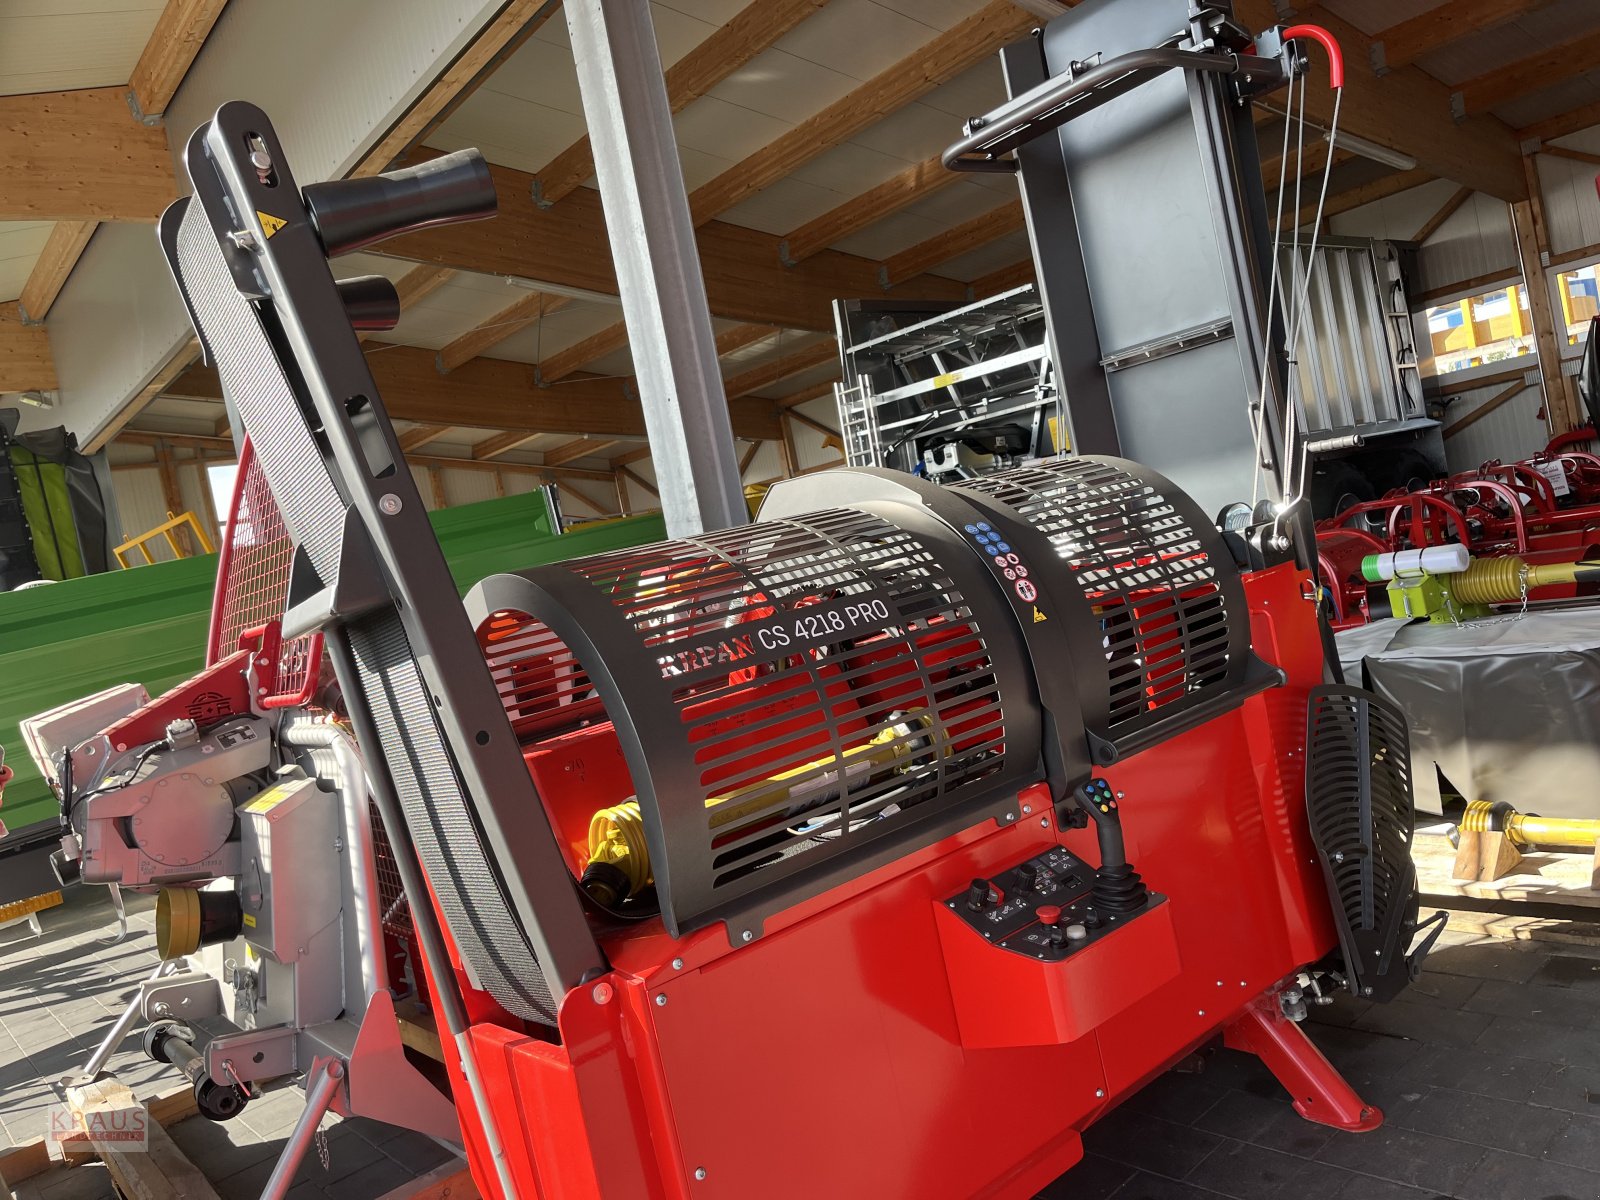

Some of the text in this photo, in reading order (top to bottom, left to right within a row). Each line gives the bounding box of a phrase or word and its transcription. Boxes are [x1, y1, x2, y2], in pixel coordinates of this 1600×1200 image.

[656, 599, 889, 679] KRPAN CS 4218 PRO
